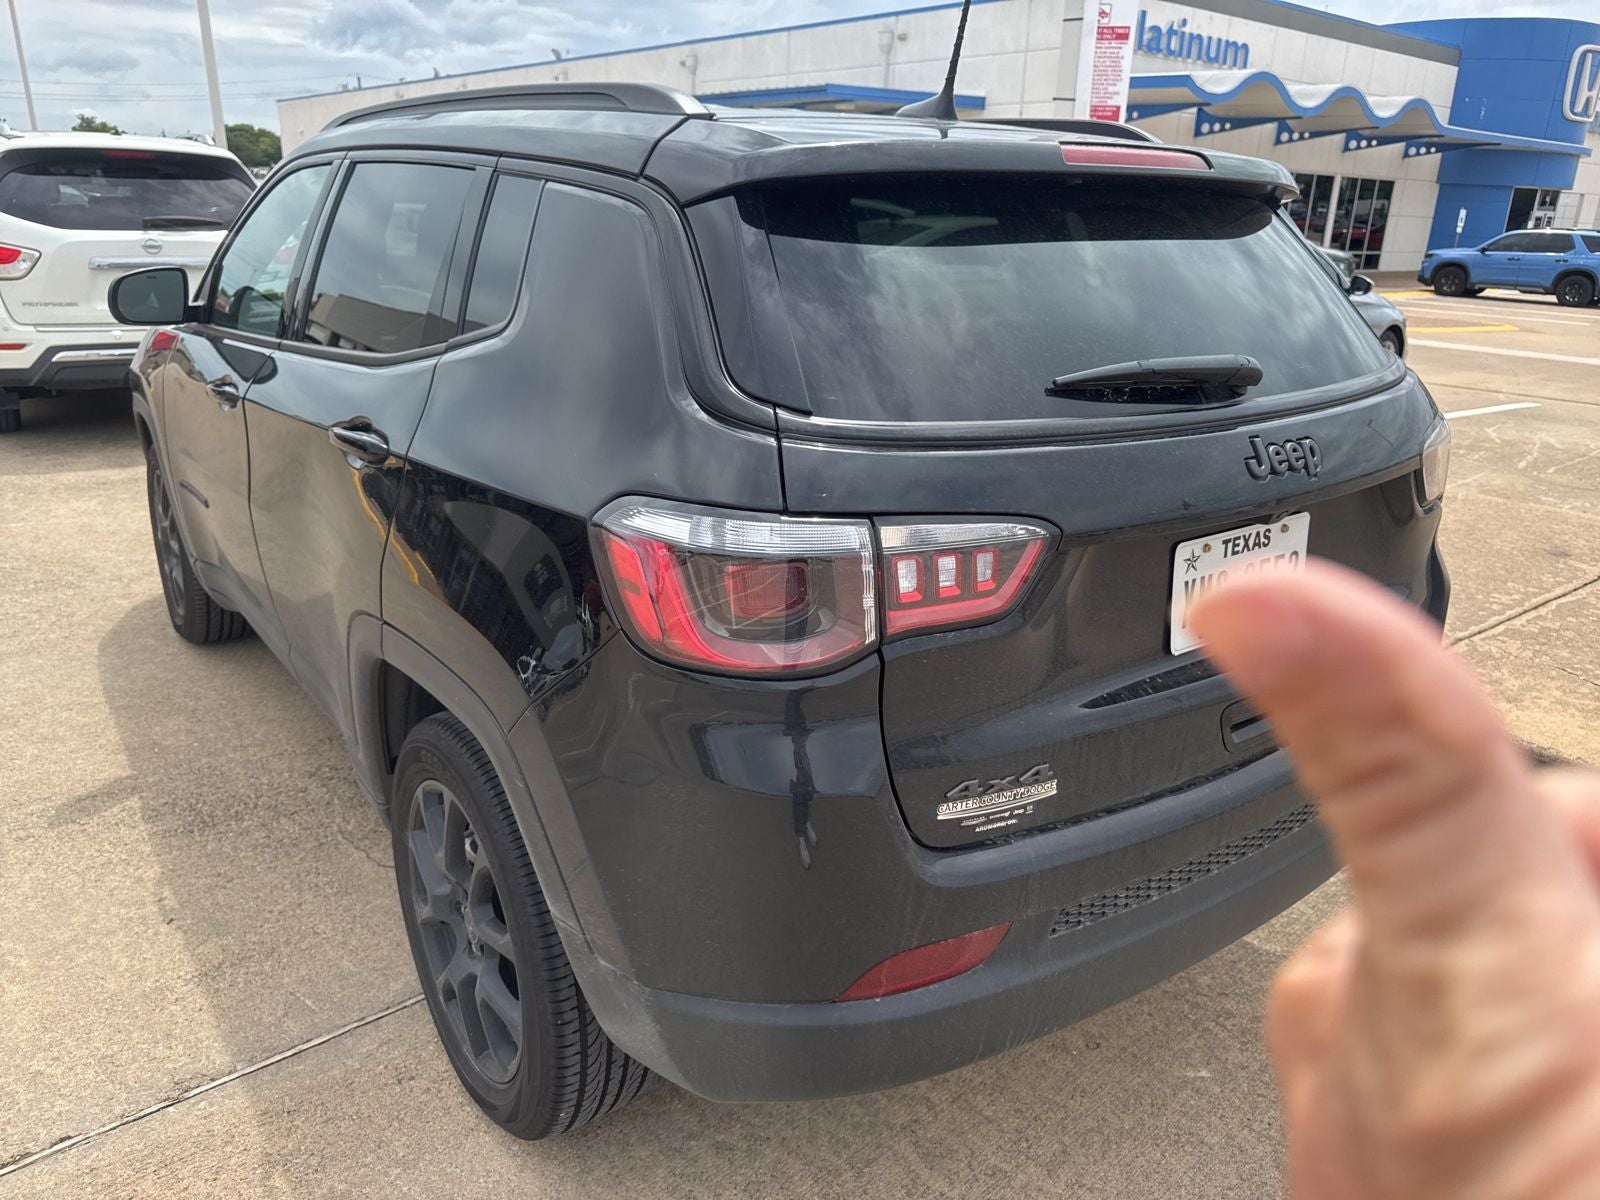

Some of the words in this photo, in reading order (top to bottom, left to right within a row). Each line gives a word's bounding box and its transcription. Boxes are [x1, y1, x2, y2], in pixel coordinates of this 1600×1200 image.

[1137, 9, 1250, 69] latinum
[1244, 434, 1323, 483] Jeep
[1222, 528, 1272, 559] TEXAS
[937, 797, 979, 814] CARTER
[980, 788, 1024, 806] COUNTY
[1023, 779, 1058, 797] DODGE
